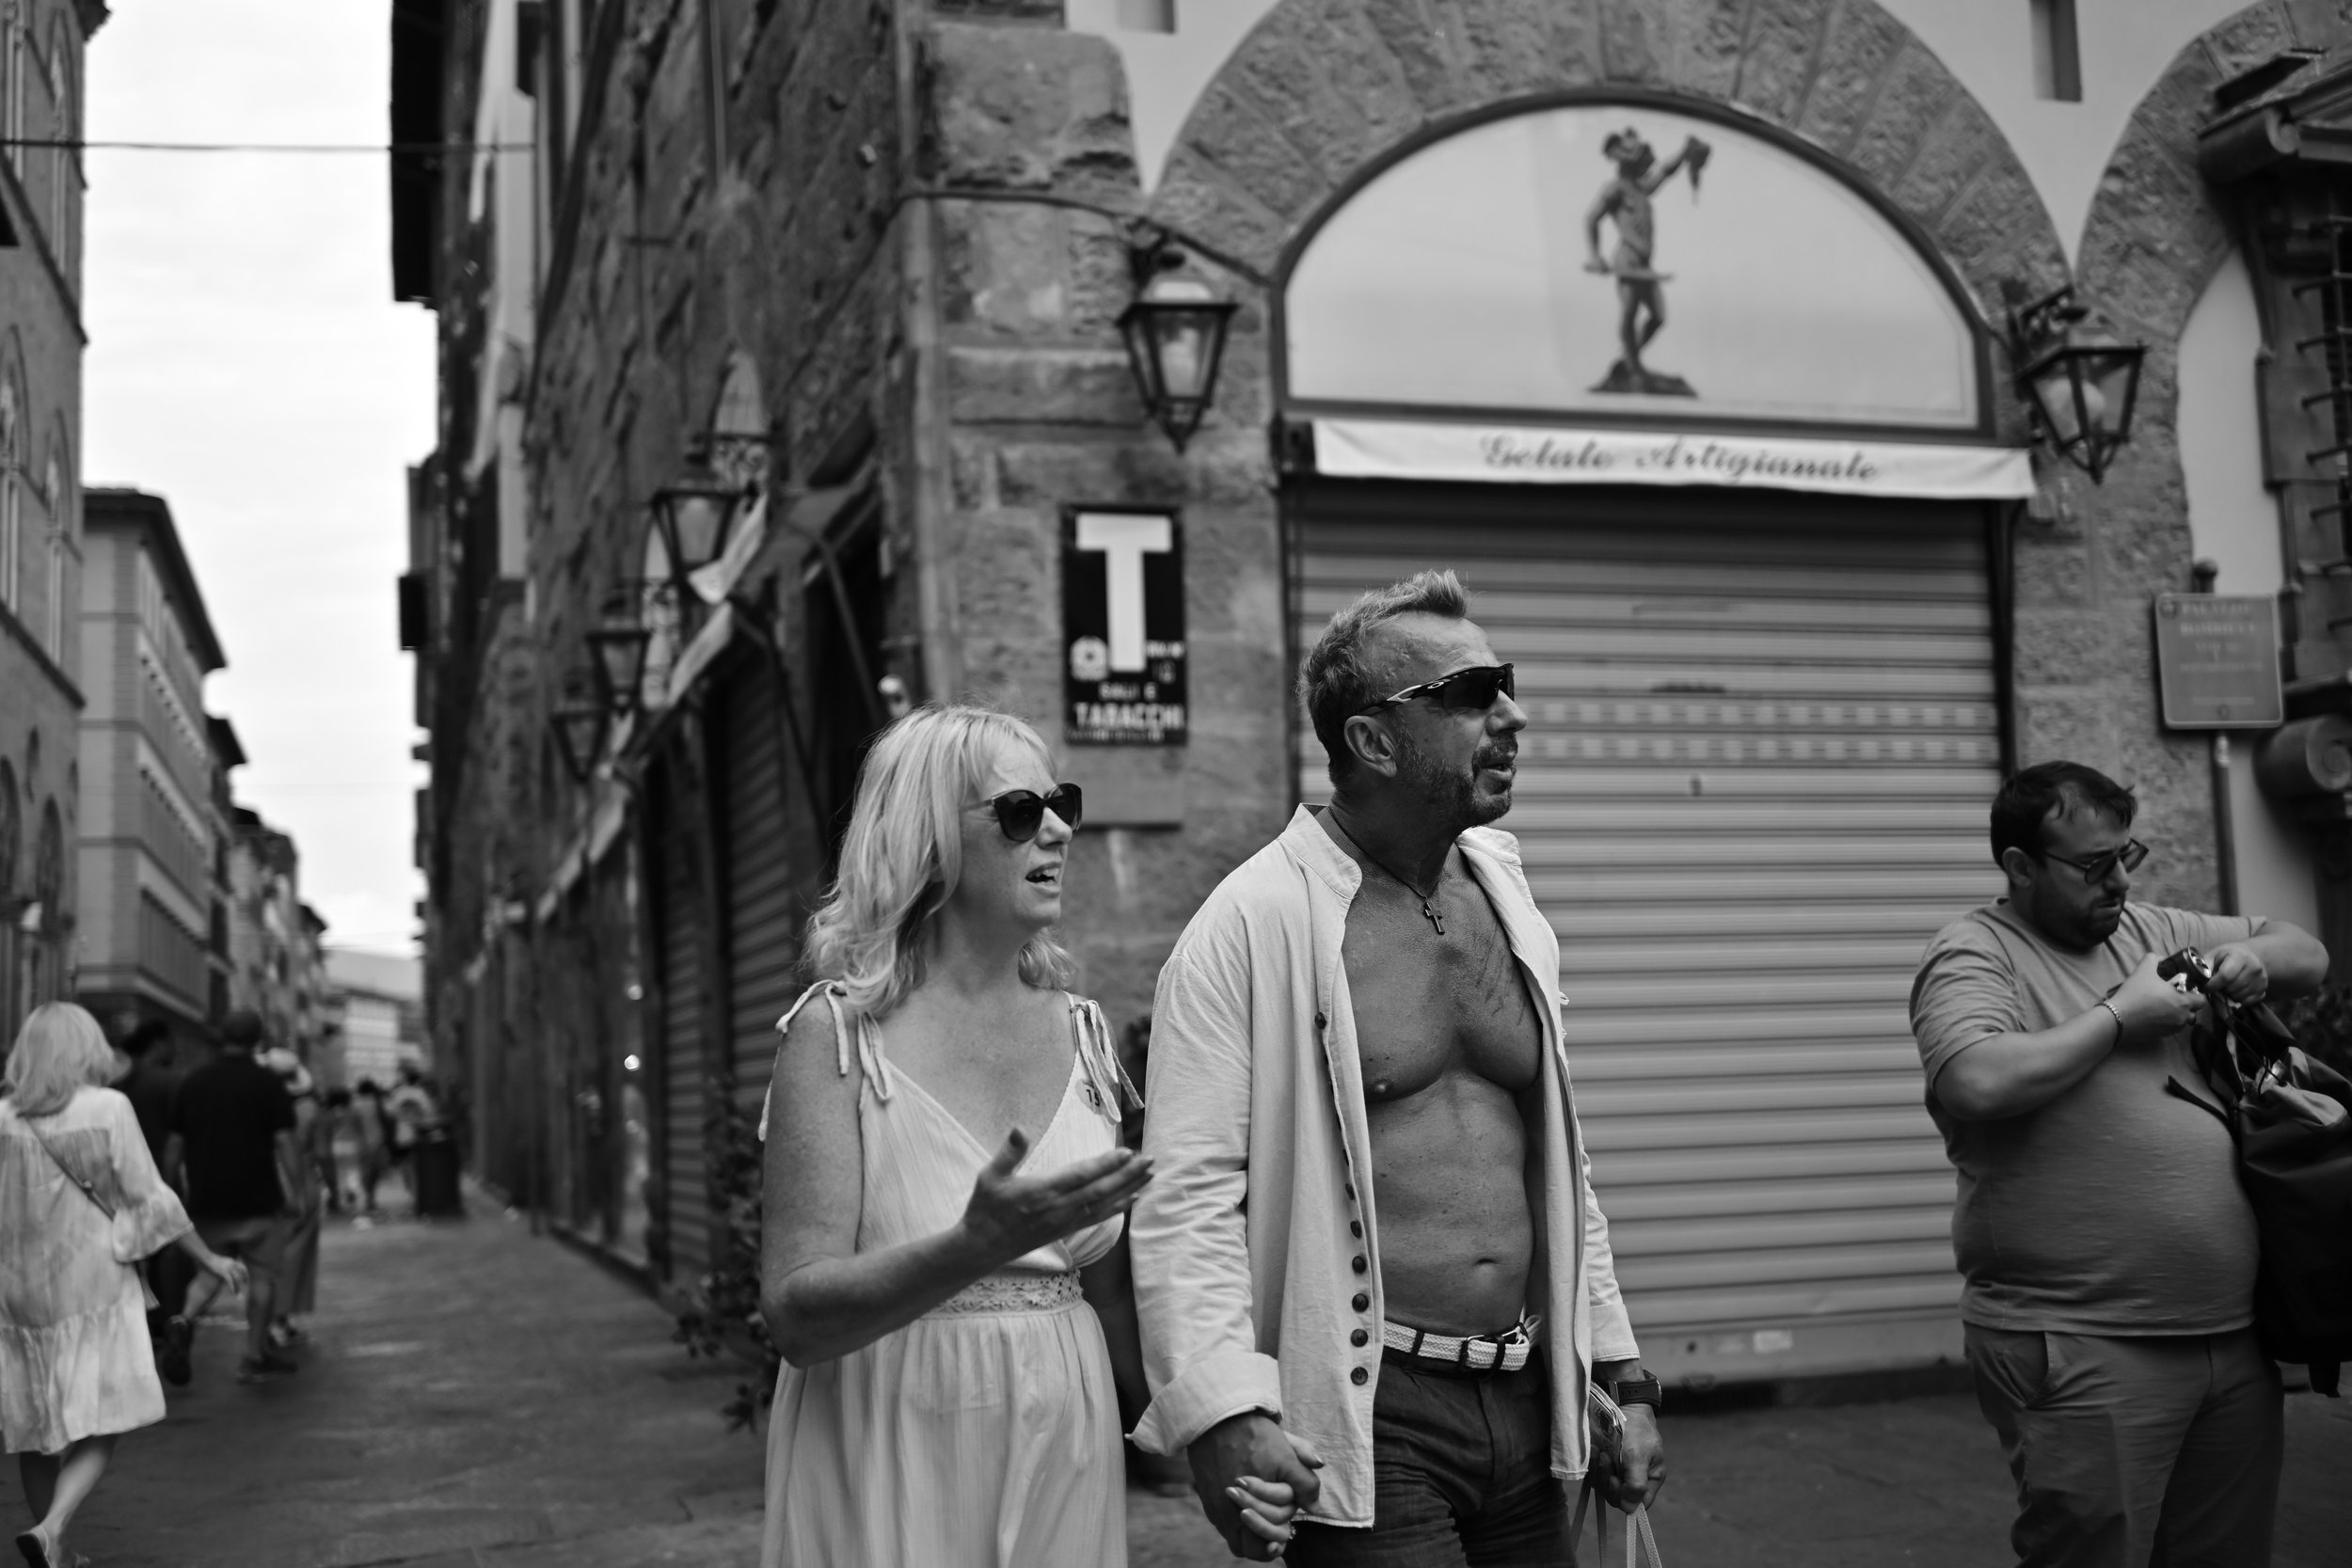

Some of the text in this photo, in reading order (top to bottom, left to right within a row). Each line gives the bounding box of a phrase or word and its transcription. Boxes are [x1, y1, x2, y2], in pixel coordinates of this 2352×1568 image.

[1635, 435, 1880, 483] Artigianale
[1075, 512, 1173, 673] T
[1073, 703, 1184, 730] TABACCHI
